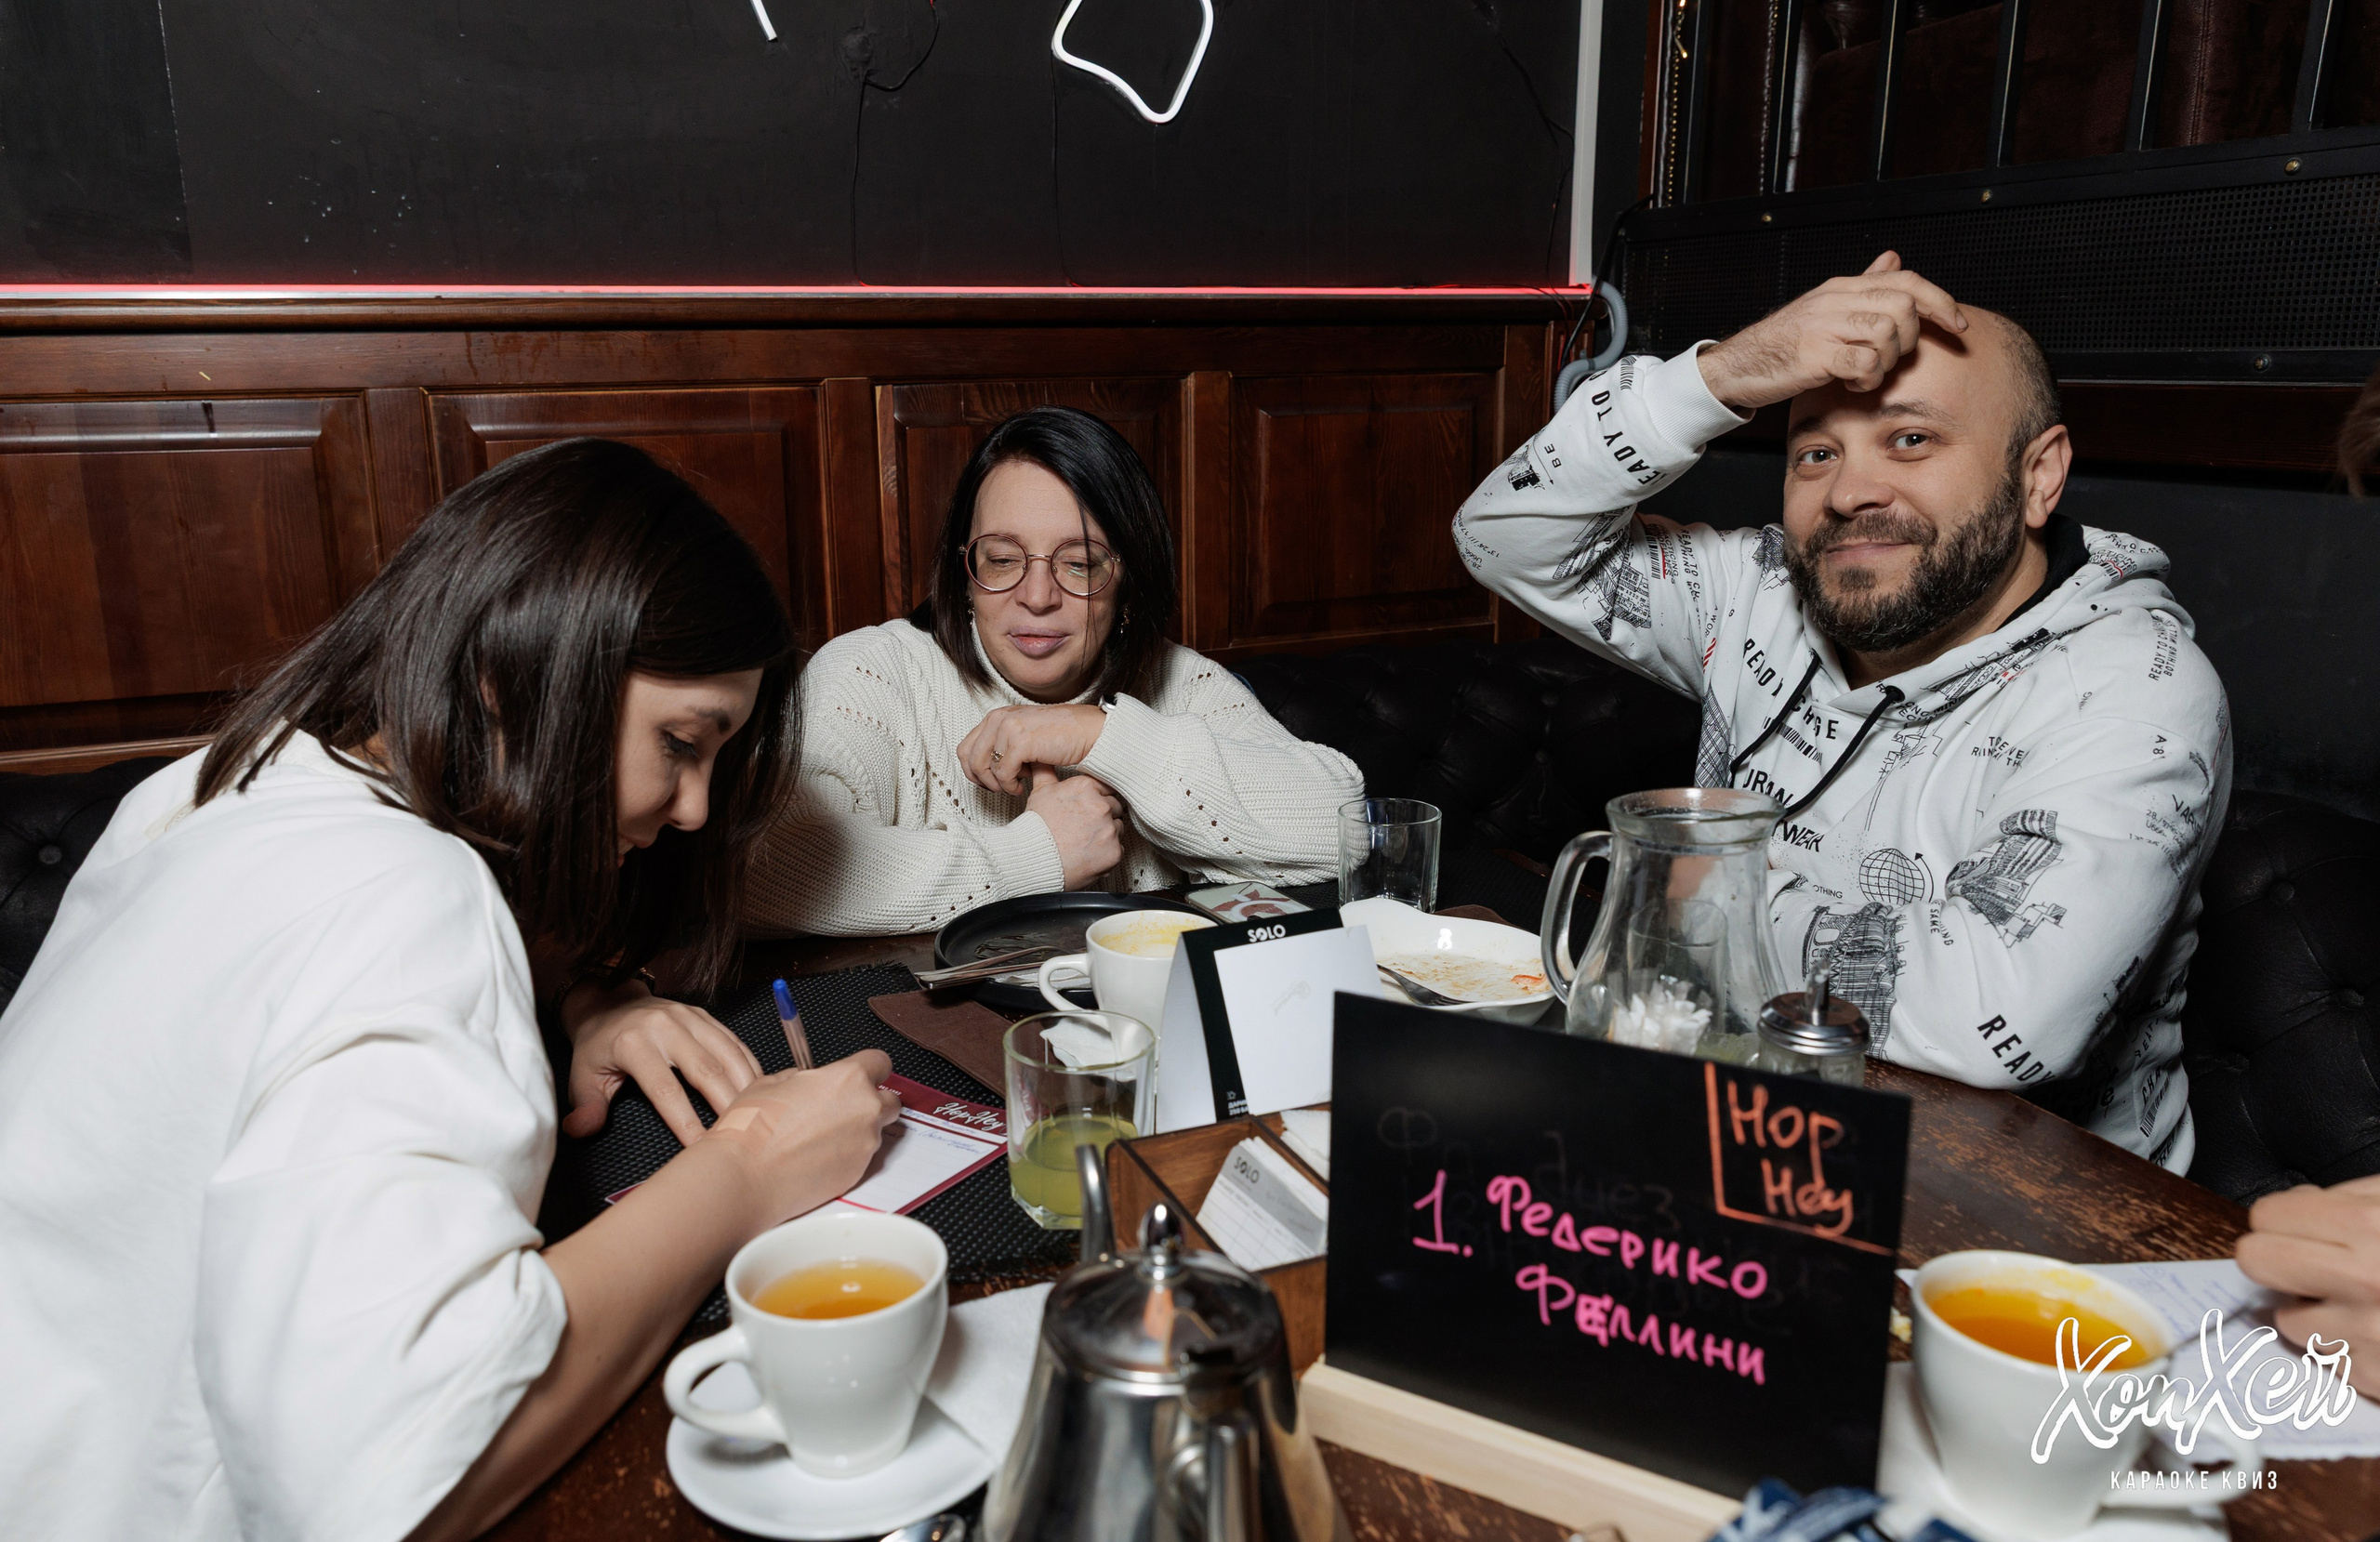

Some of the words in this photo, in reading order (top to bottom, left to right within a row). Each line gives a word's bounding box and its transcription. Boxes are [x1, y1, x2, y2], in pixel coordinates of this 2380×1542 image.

[1544, 443, 1562, 468] BE
[2149, 652, 2166, 680] READY
[1247, 924, 1286, 942] SOLO
[1977, 1014, 2056, 1087] READY
[1233, 1156, 1261, 1184] SOLO
